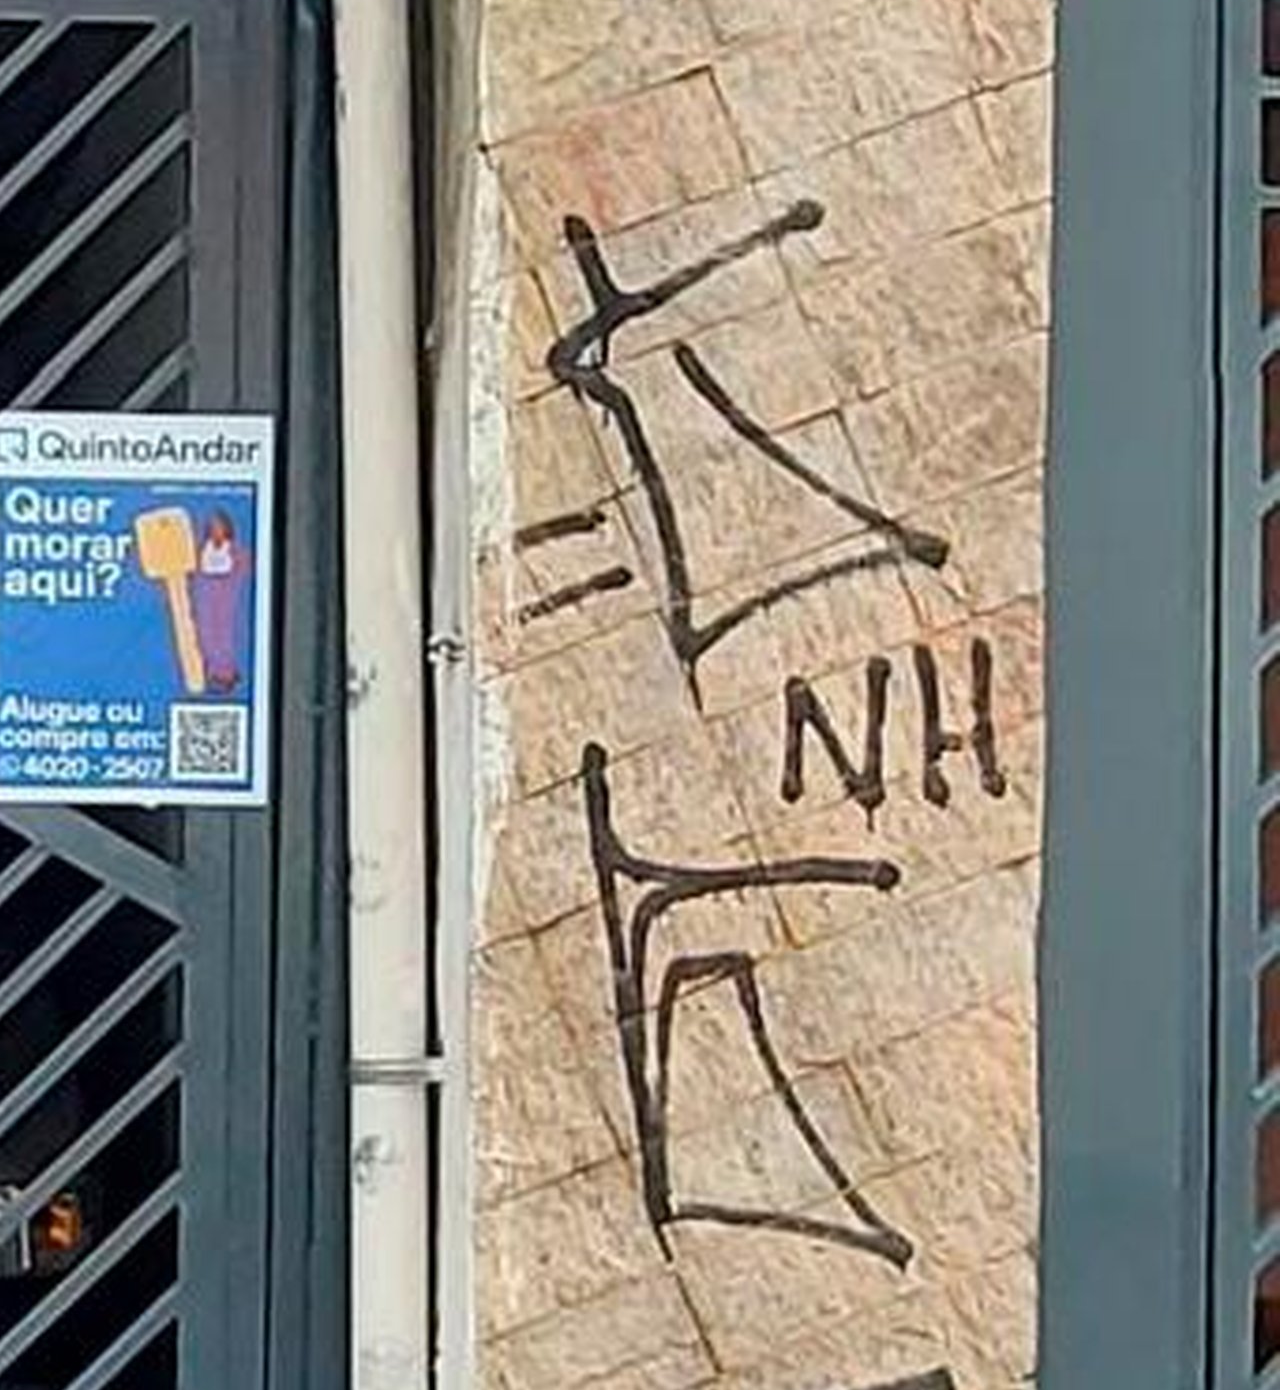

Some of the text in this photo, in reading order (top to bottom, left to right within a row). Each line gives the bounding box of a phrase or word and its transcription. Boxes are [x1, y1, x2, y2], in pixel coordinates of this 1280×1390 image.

[39, 430, 260, 464] QuintoAndar
[5, 486, 114, 525] Quer
[5, 532, 133, 561] morar
[4, 561, 122, 605] aqui?
[105, 702, 144, 724] ou
[114, 730, 167, 749] em:
